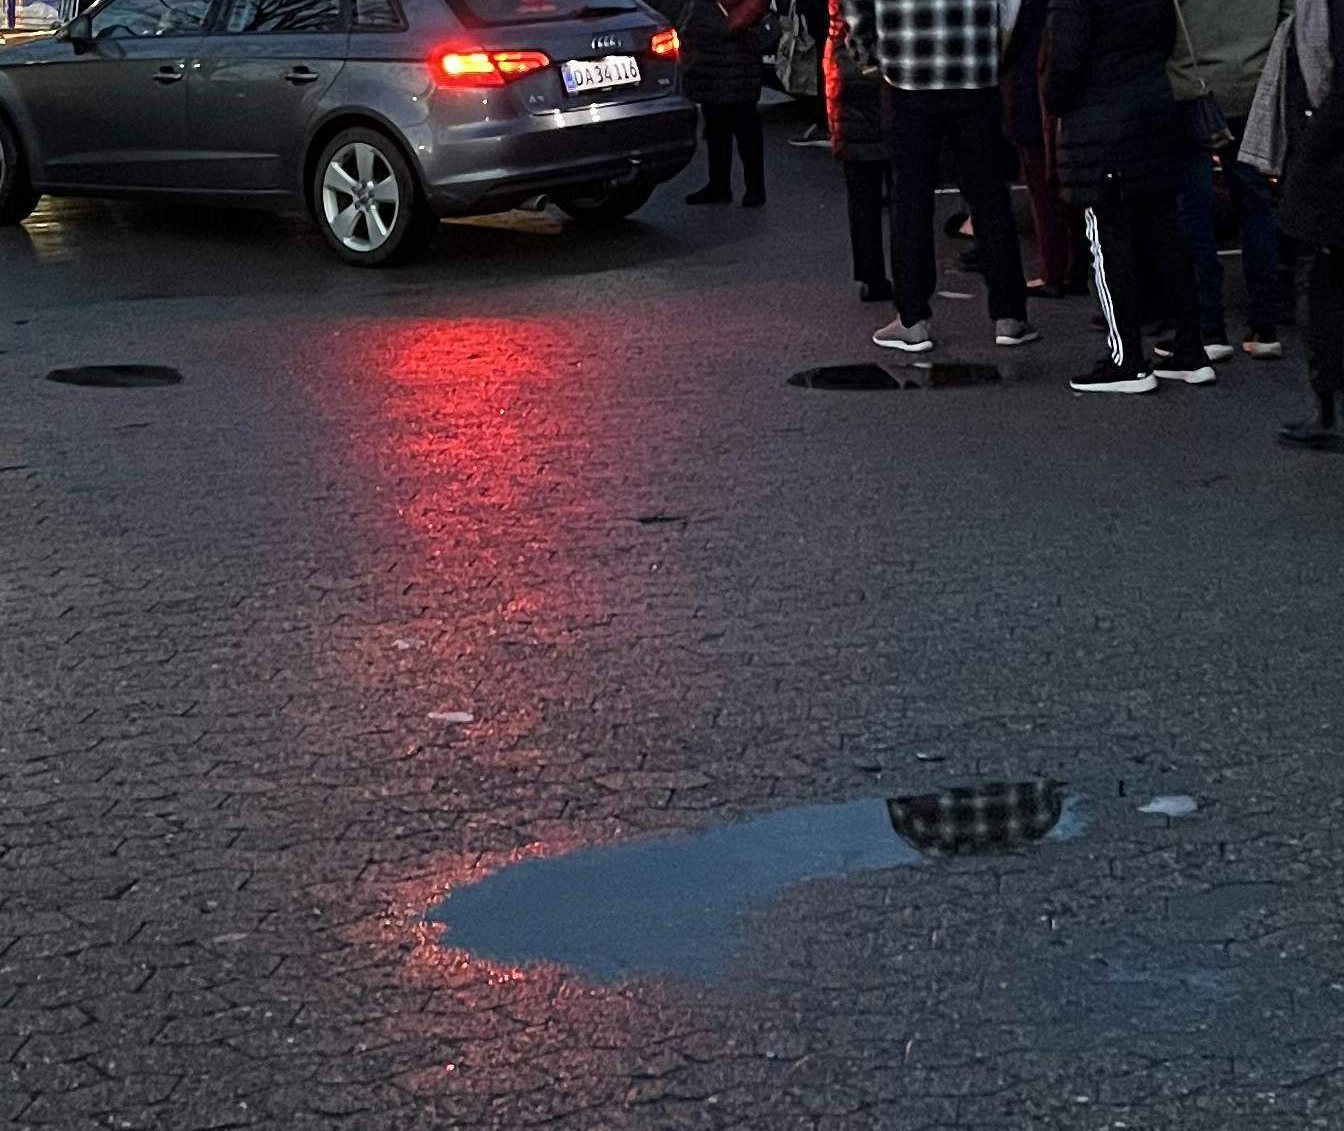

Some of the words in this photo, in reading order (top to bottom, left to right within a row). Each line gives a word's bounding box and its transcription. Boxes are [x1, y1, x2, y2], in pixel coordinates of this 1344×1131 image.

[574, 68, 594, 86] DA
[595, 65, 613, 84] 34
[614, 61, 637, 80] 116
